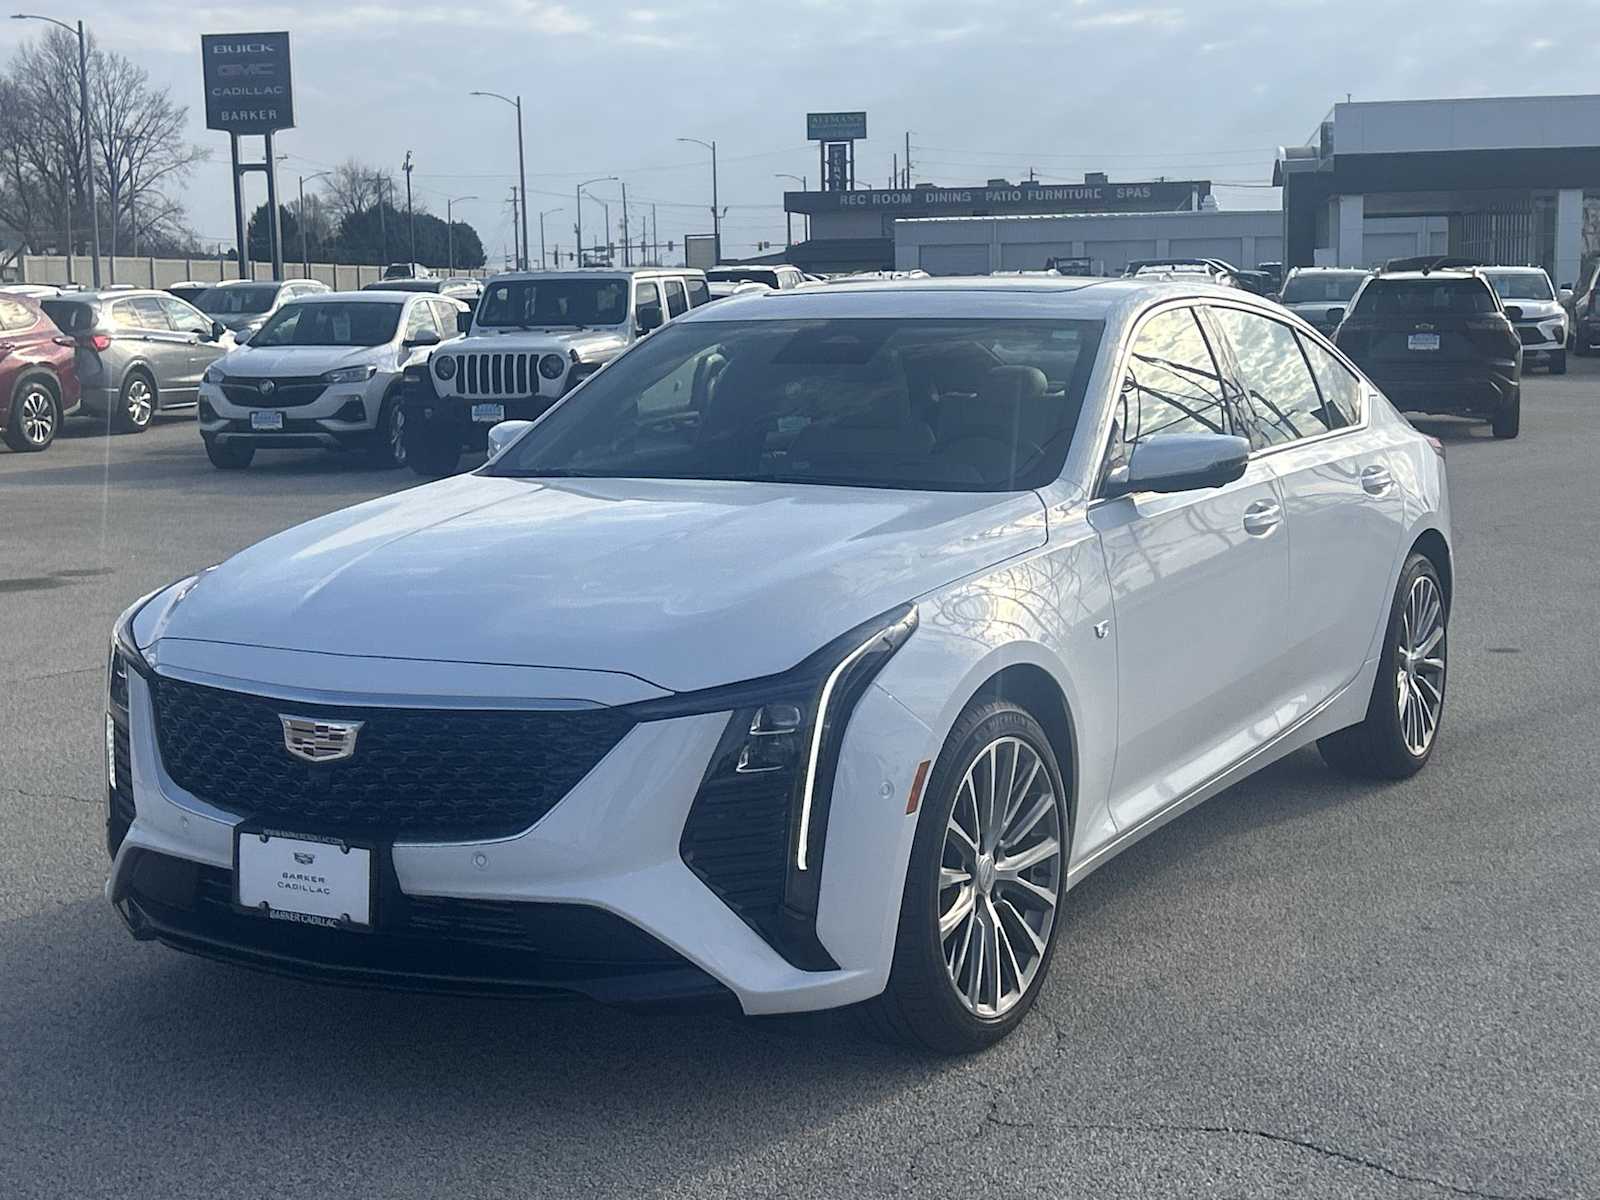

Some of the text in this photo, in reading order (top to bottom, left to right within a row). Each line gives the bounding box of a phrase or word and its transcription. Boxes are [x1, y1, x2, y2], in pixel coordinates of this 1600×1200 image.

[213, 43, 275, 54] BUICK
[217, 63, 275, 77] GMC
[212, 86, 284, 96] CADILLAC
[221, 109, 278, 120] BARKER
[840, 186, 1151, 205] REC ROOM DINING PATIO FURNITURE SPAS
[282, 871, 326, 884] BARKER
[277, 881, 331, 895] CADILLAC
[270, 909, 337, 928] BARKER CADILLAC
